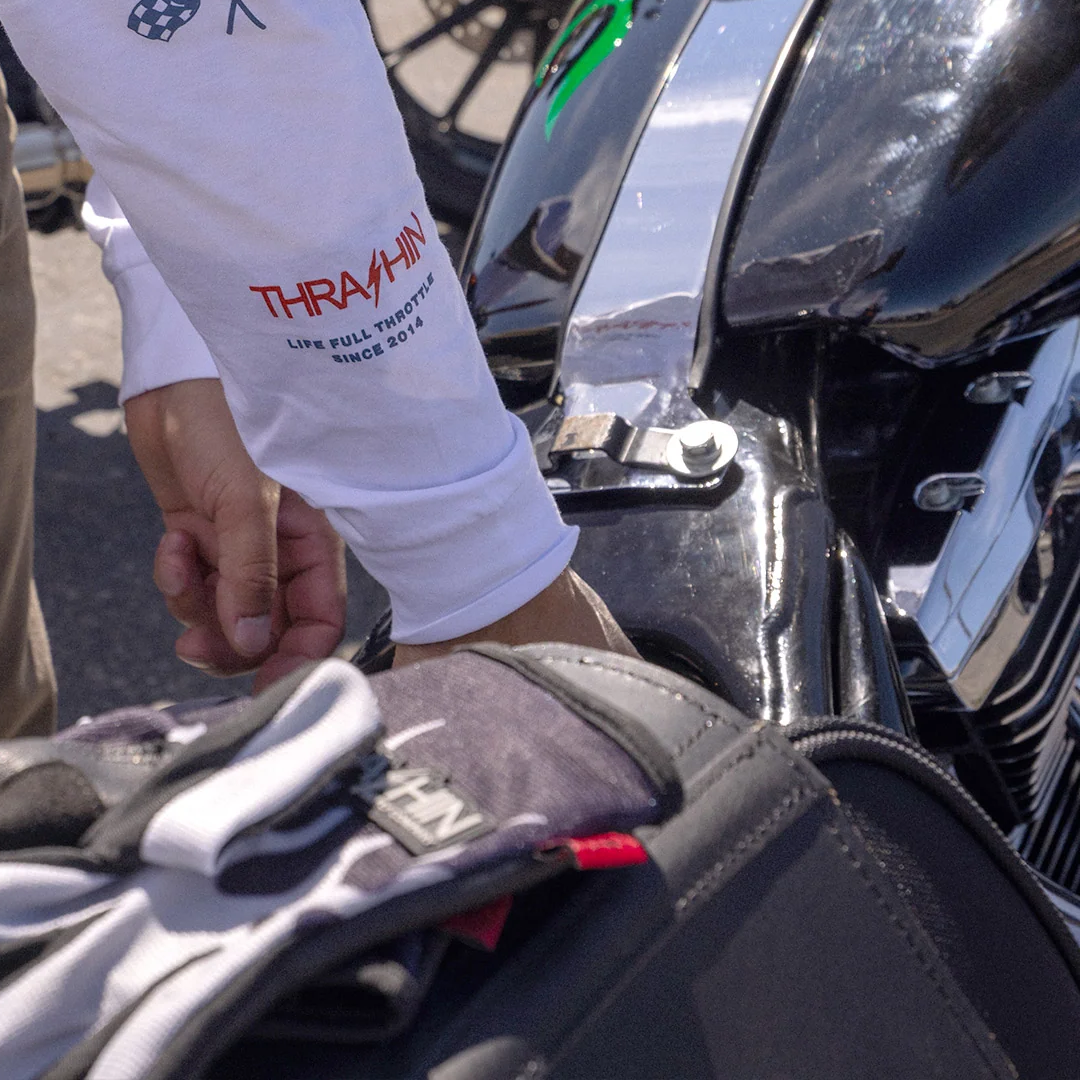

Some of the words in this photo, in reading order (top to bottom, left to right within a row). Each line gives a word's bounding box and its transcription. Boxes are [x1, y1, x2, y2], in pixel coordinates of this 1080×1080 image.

[287, 338, 325, 350] LIFE
[329, 329, 372, 349] FULL
[374, 272, 435, 333] THROTTLE
[332, 343, 385, 363] SINCE
[387, 316, 424, 348] 2014
